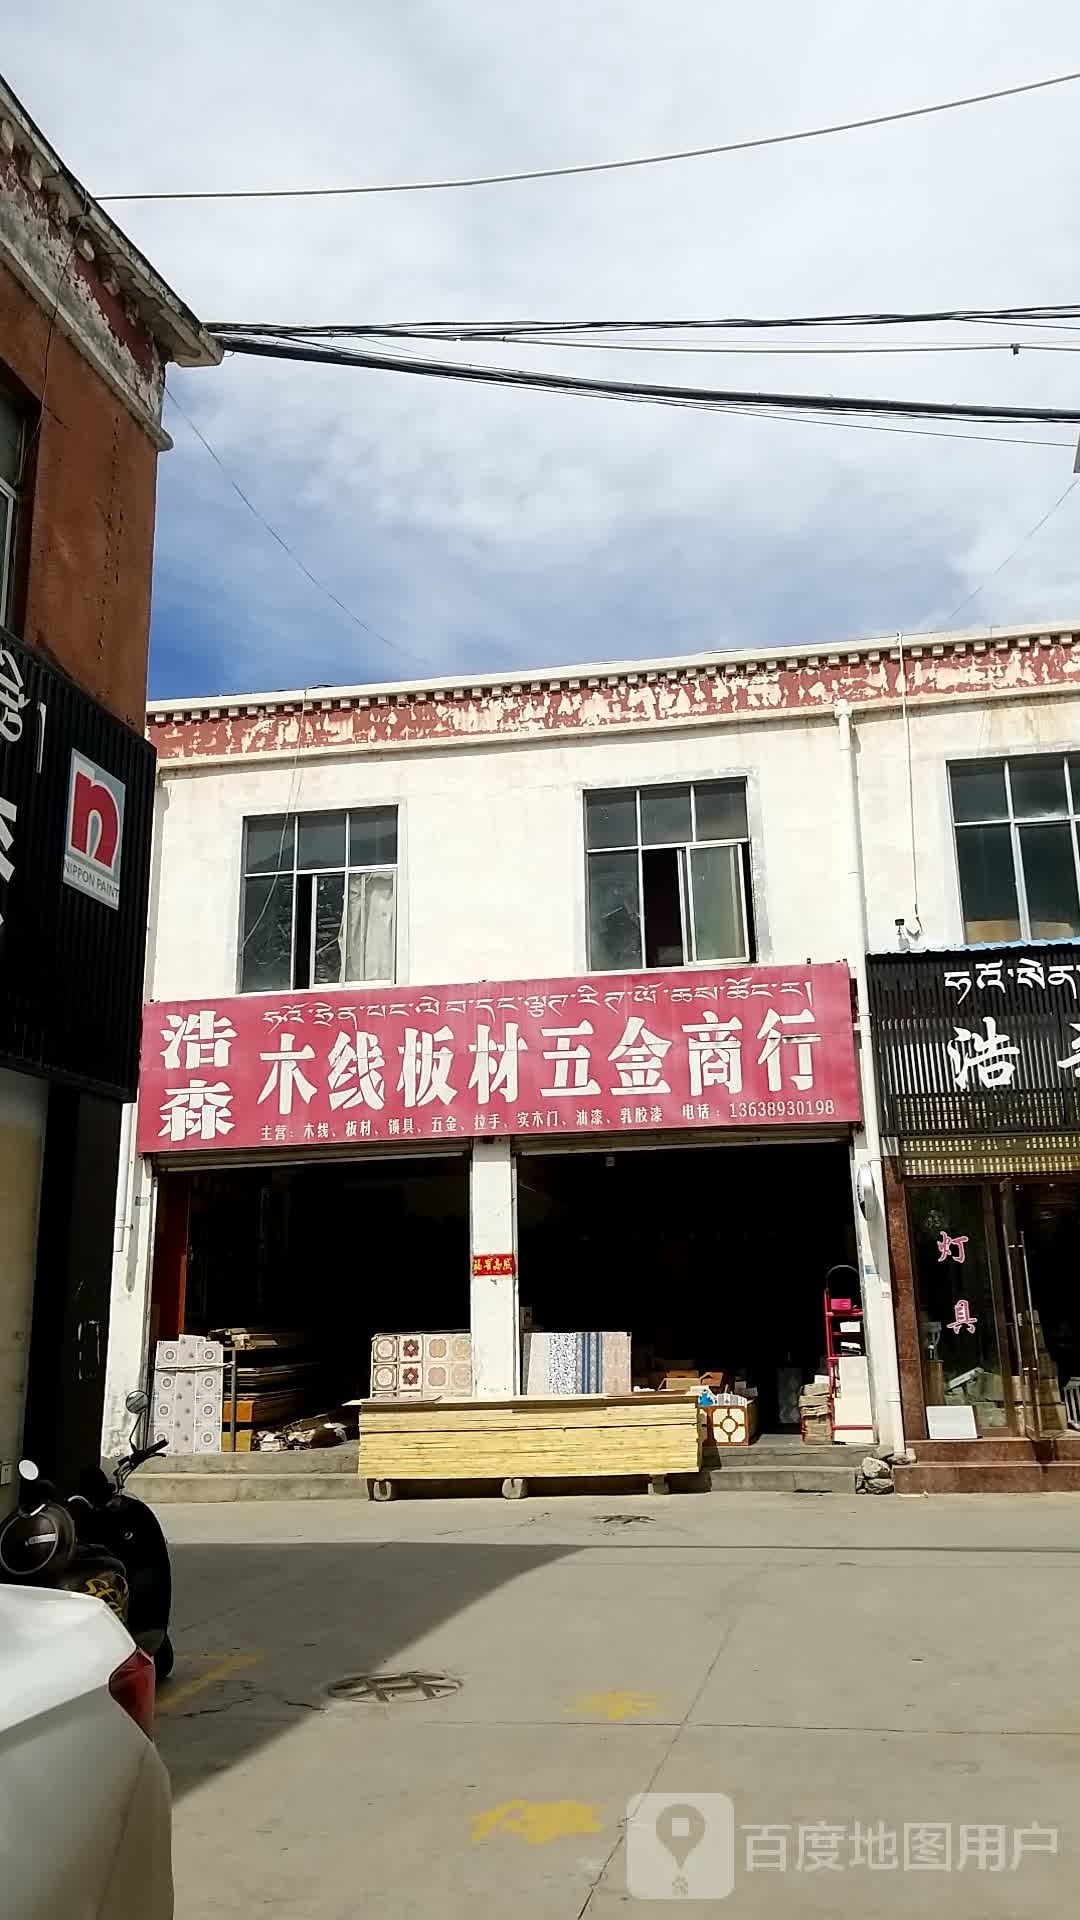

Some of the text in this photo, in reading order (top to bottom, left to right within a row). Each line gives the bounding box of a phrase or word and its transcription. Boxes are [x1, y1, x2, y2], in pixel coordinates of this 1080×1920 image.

[64, 860, 118, 899] NIPPON PAINT
[158, 1010, 238, 1142] 浩森
[257, 1008, 822, 1115] 木线板材五金商行
